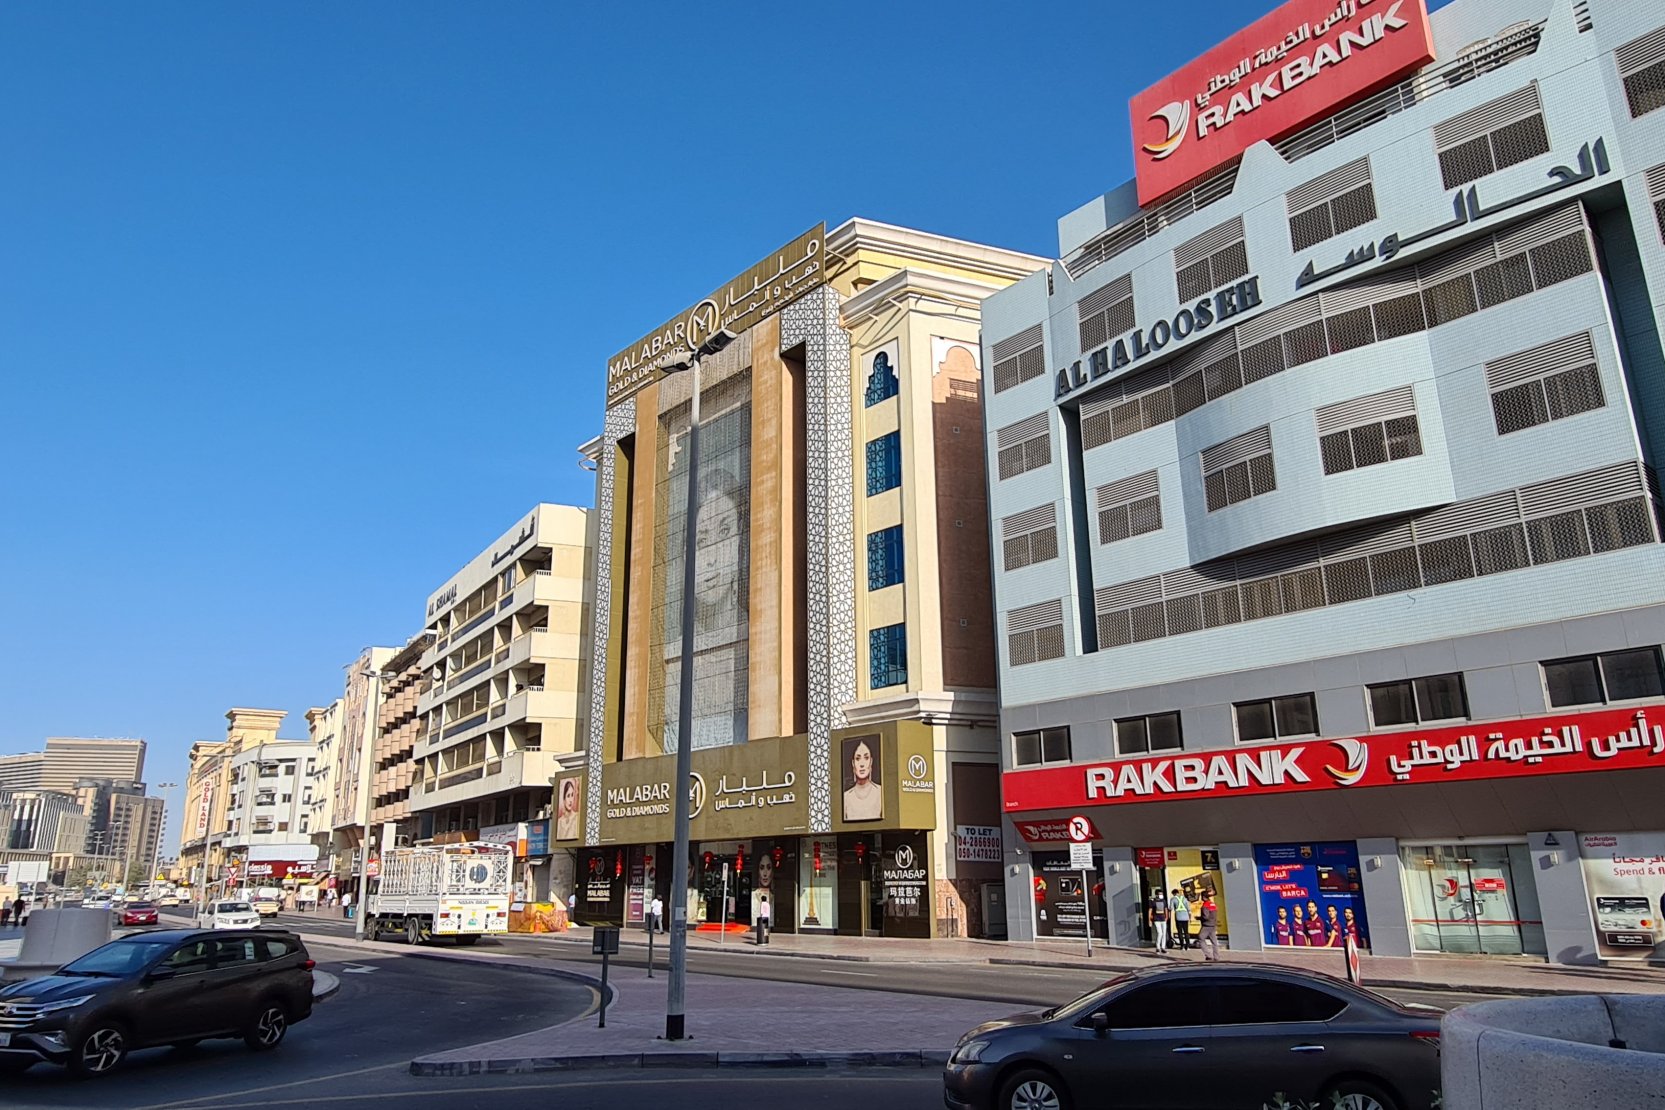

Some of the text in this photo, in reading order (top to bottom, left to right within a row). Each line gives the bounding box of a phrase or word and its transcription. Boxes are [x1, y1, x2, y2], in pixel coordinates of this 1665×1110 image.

[1254, 22, 1310, 68] الخيمة
[1196, 58, 1251, 107] الوطني
[1197, 0, 1409, 138] RAKBANK
[608, 321, 686, 383] MALABAR
[608, 376, 631, 396] GOLD
[631, 372, 639, 383] &
[639, 343, 686, 378] DIAMONDS
[1389, 710, 1665, 780] رأس الخيمة الوطني
[606, 782, 670, 806] MALABAR
[714, 770, 796, 797] مليبار
[902, 780, 934, 789] MALABAR
[1086, 746, 1312, 798] RAKBANK
[199, 781, 211, 829] GOLD LAND
[606, 803, 670, 818] GOLD & DIAMONDS
[965, 828, 993, 836] TO LET
[883, 869, 926, 879] МАЛАБАР
[1613, 866, 1645, 877] Spend
[1648, 867, 1655, 875] &
